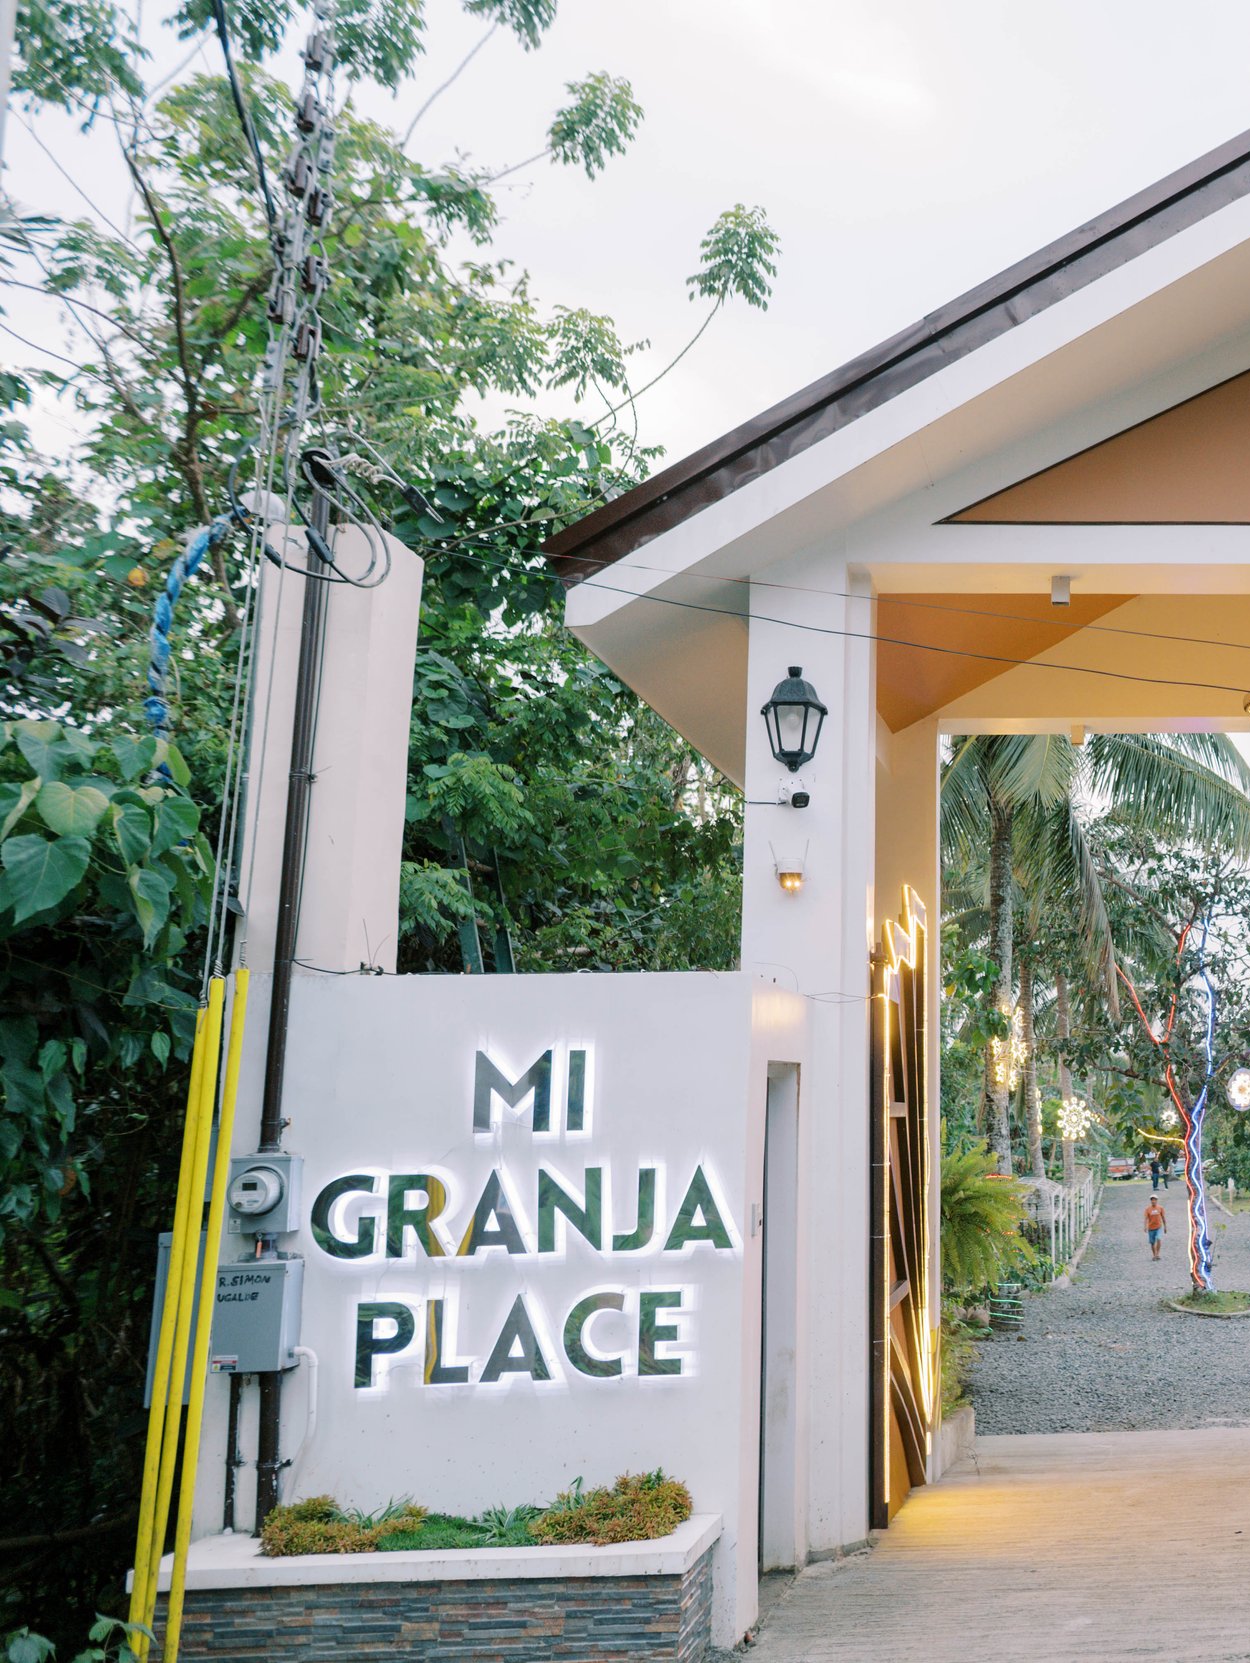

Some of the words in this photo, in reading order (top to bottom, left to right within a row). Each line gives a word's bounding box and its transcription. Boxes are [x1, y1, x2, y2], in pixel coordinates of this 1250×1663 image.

[472, 1048, 587, 1134] MI
[310, 1163, 734, 1259] GRANJA
[353, 1290, 683, 1389] PLACE
